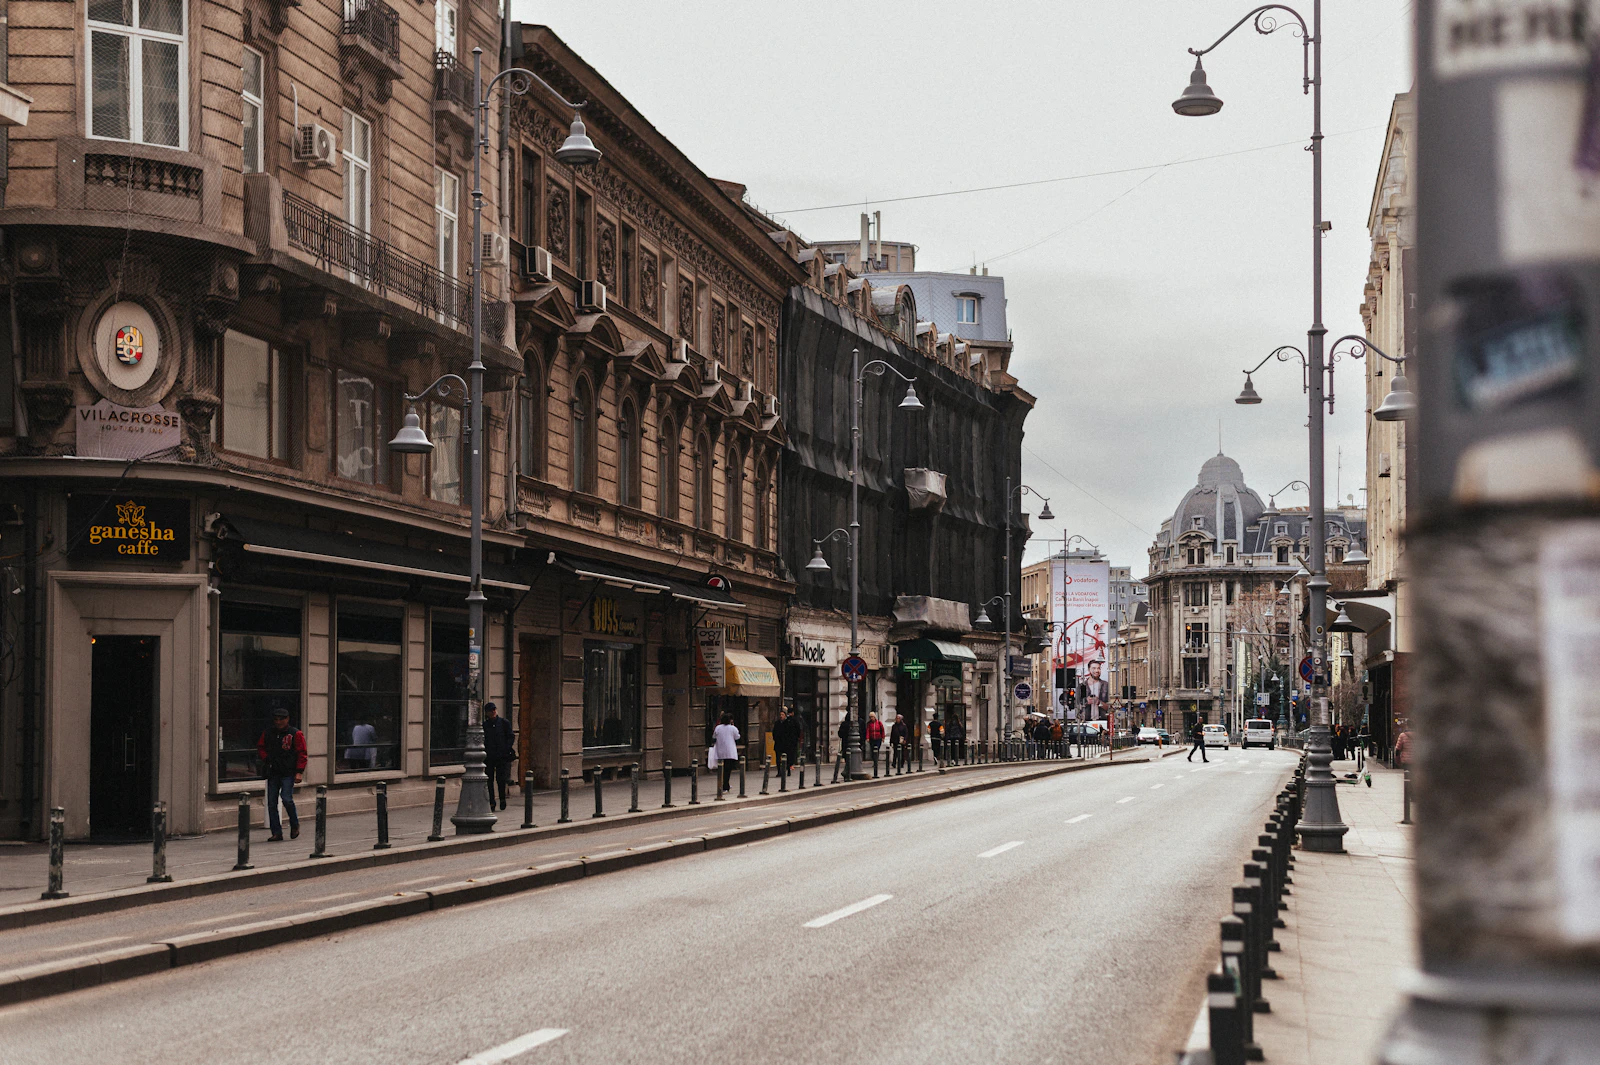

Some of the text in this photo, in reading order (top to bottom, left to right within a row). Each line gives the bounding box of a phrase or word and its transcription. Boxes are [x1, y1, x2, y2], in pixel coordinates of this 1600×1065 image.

[80, 409, 179, 428] VILACROSSE
[89, 521, 175, 545] ganesha
[117, 540, 159, 555] caffe
[592, 597, 618, 634] BOSS
[802, 641, 826, 663] Noelle
